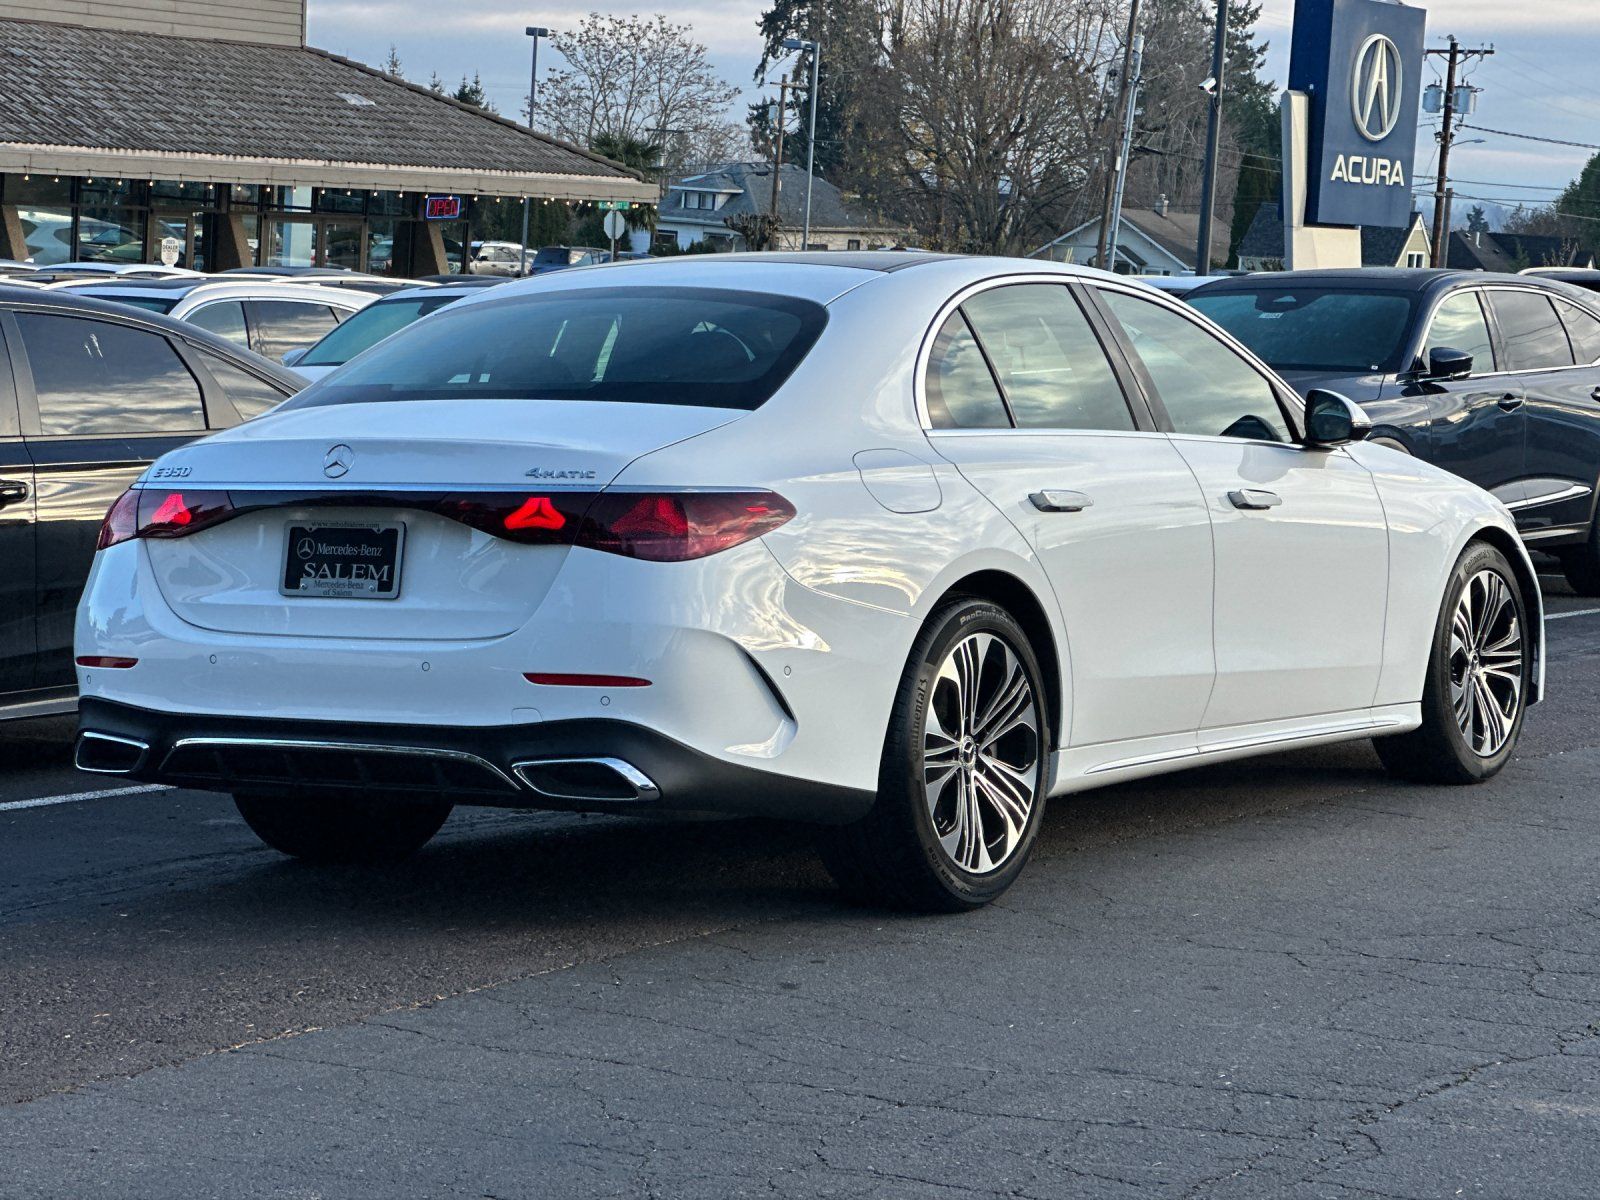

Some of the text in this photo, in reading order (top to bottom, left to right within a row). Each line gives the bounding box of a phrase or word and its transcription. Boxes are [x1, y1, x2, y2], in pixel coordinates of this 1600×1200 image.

[1330, 154, 1405, 187] ACURA
[429, 200, 459, 217] OPEN
[153, 467, 193, 478] E350
[525, 467, 596, 479] 4MATIC
[316, 543, 383, 556] Mercedes-Benz
[302, 562, 391, 581] SALEM
[314, 580, 364, 589] Mercedes-Benz
[322, 588, 332, 596] of
